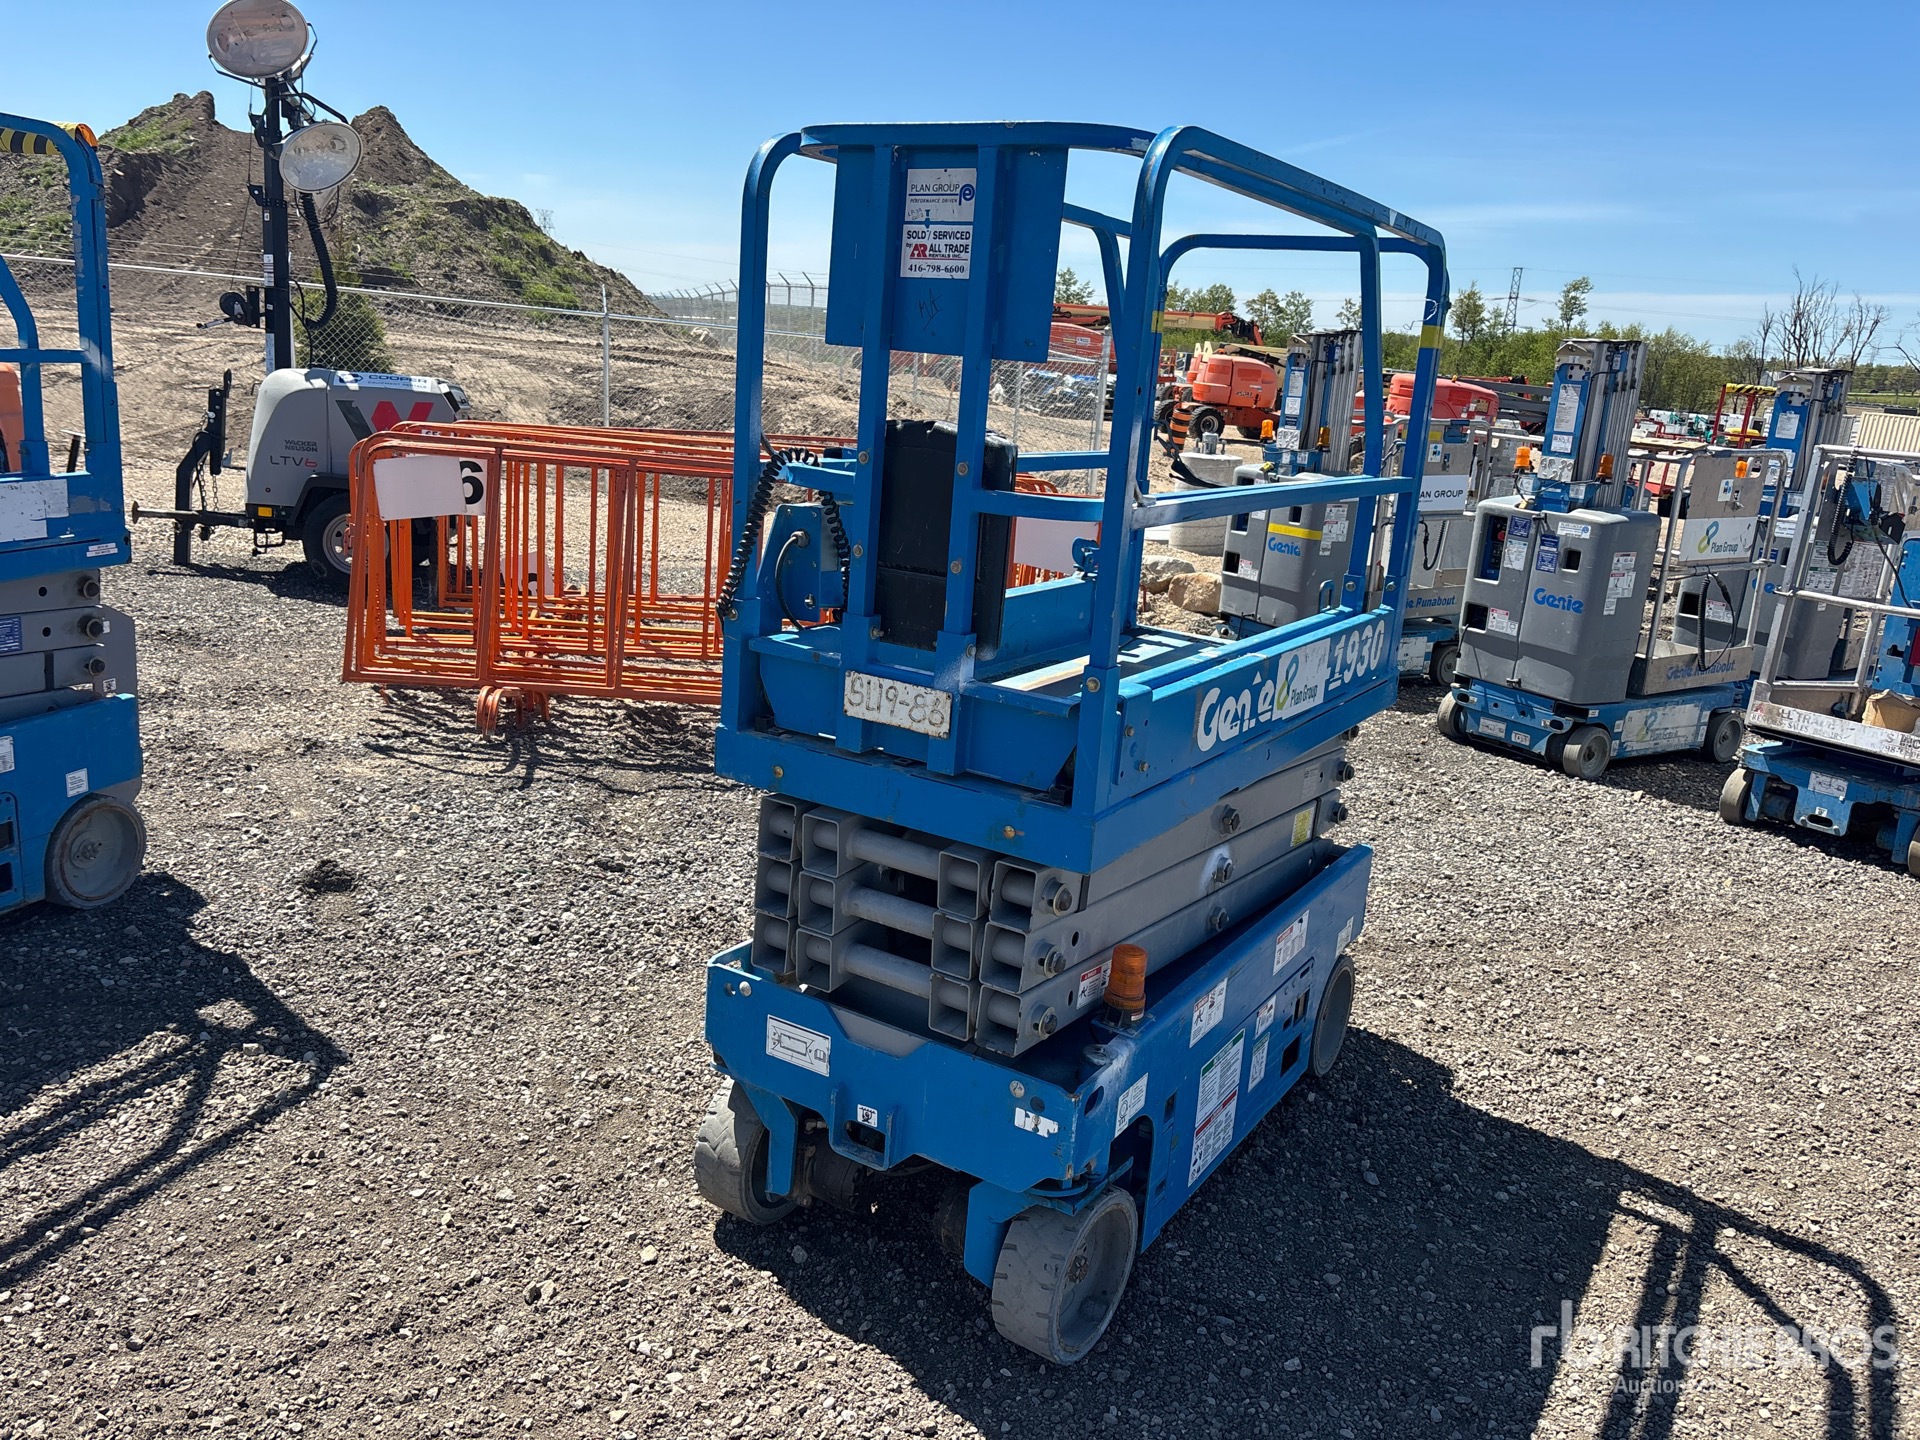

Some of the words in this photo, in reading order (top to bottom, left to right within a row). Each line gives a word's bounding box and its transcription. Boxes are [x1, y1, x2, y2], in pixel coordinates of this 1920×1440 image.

[910, 184, 931, 192] PLAN
[932, 184, 960, 192] GROUP
[906, 230, 927, 240] SOLD
[932, 231, 971, 241] SERVICED
[928, 243, 943, 253] ALL
[944, 244, 970, 254] TRADE
[908, 264, 965, 274] 416-798-6600
[369, 374, 427, 383] COOPER
[284, 439, 318, 447] WACKER
[269, 455, 318, 468] LTV6
[1433, 489, 1464, 499] GROUP
[1267, 536, 1302, 557] Genie
[1711, 542, 1722, 553] Plan
[1722, 542, 1739, 555] Group
[1415, 595, 1456, 608] Runabout
[1533, 587, 1584, 614] Genie
[1328, 619, 1386, 691] 1930
[1694, 660, 1736, 677] Rabout
[1290, 687, 1304, 707] Plan
[1303, 684, 1318, 703] Group
